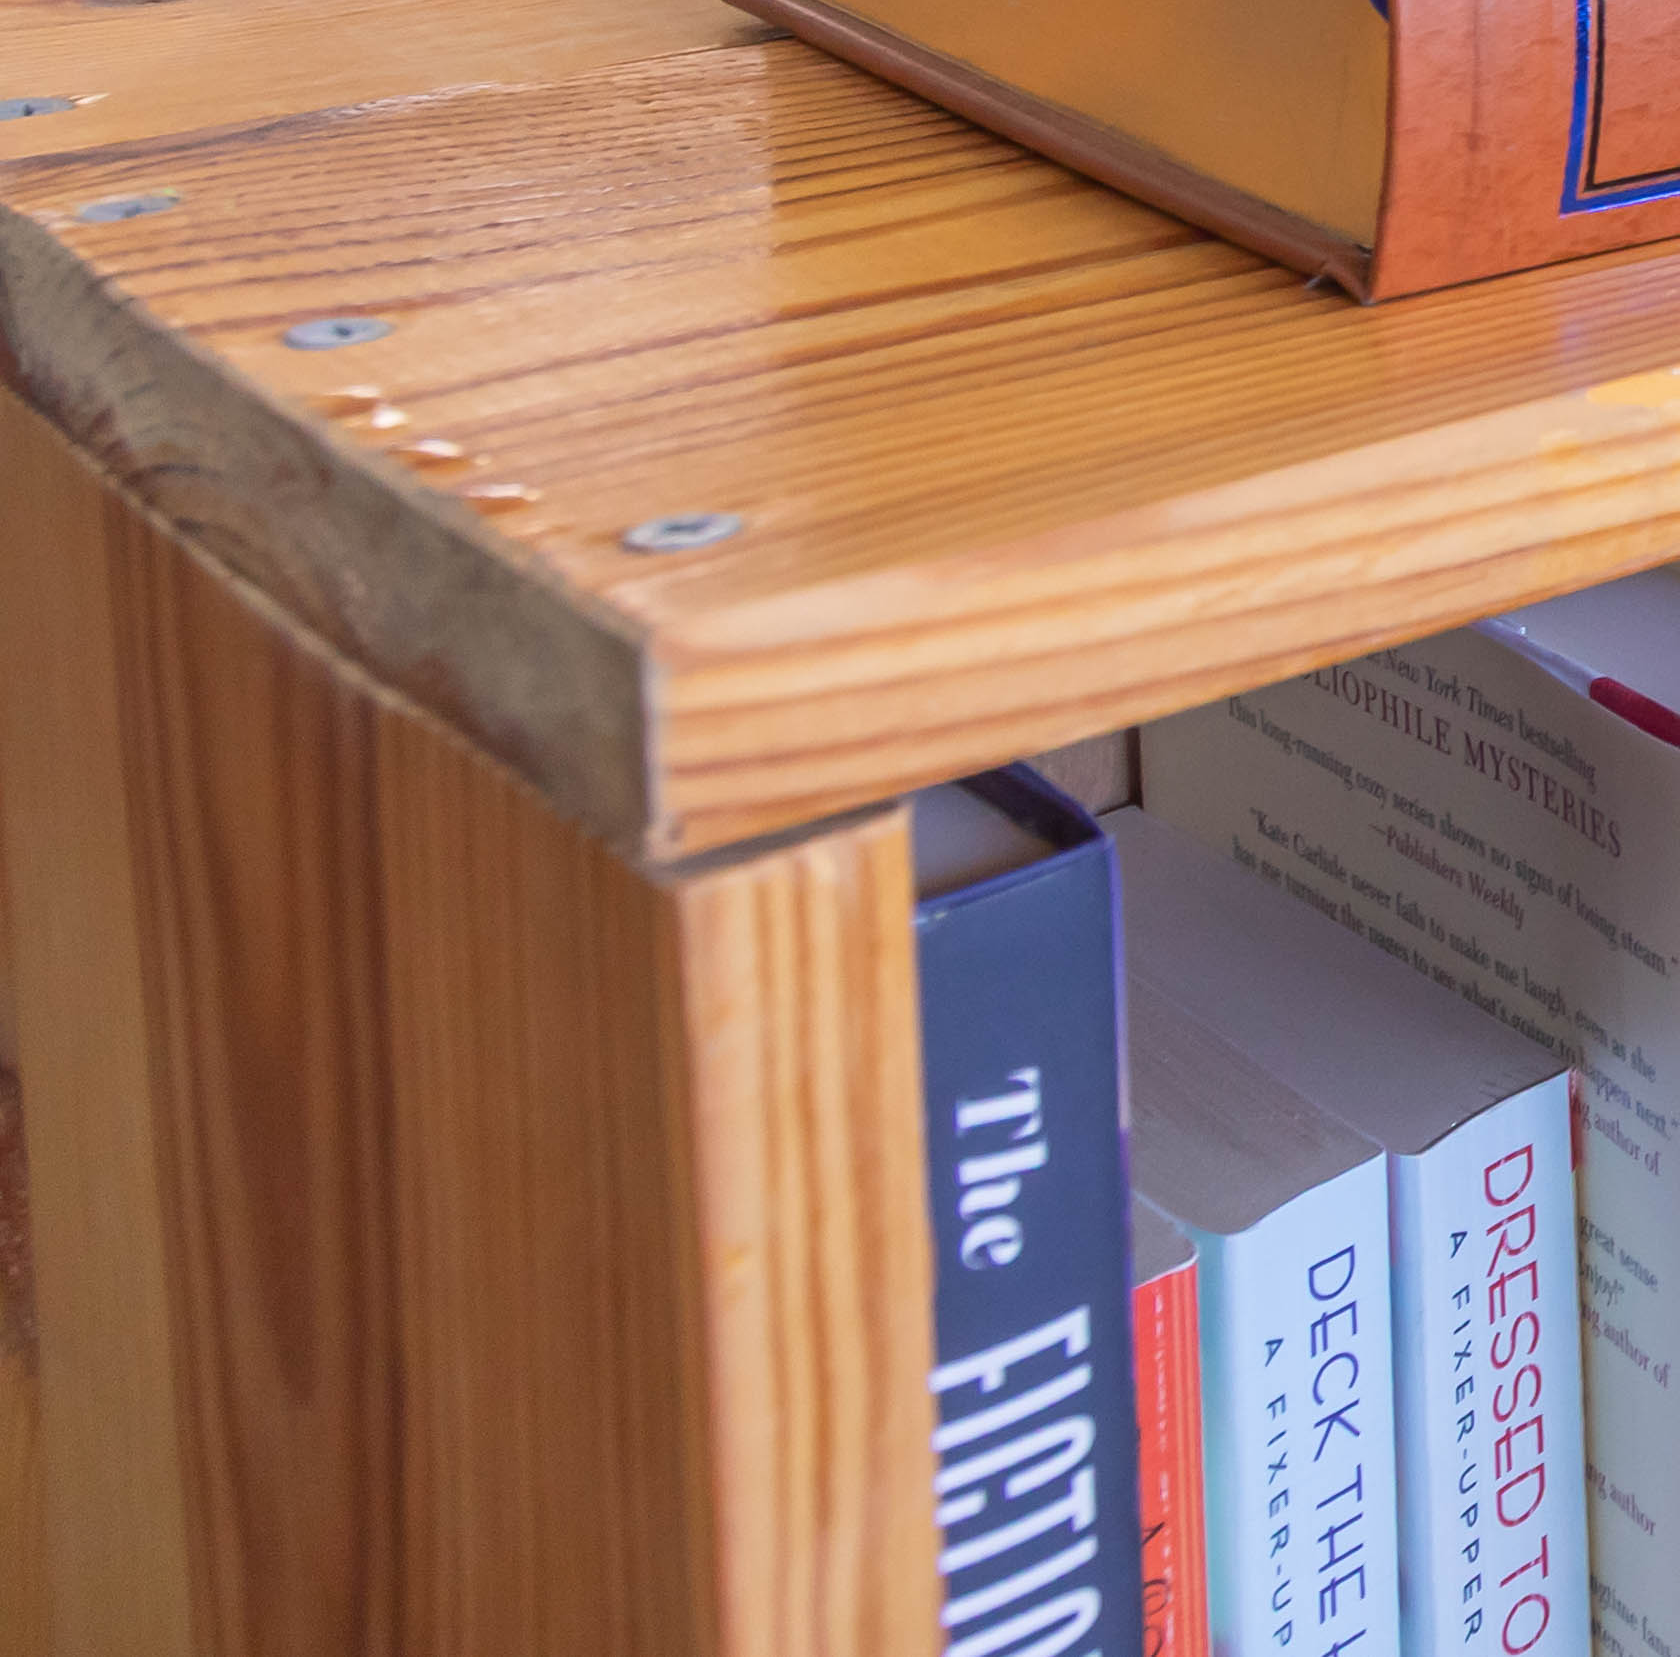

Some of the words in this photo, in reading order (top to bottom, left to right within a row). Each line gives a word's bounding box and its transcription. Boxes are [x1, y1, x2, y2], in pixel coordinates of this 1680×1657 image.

[1426, 665, 1461, 703] York
[1467, 685, 1514, 732] Times
[1517, 708, 1598, 795] bestselling
[1463, 731, 1621, 858] MYSTERIES
[1293, 833, 1347, 885] Carlisle
[1351, 874, 1392, 911] never
[1449, 925, 1491, 970] make
[1393, 790, 1435, 829] series
[1439, 811, 1496, 858] shows
[1514, 856, 1554, 898] signs
[1467, 870, 1525, 931] Weekly
[955, 1066, 1049, 1271] The
[1449, 1231, 1468, 1259] A
[1264, 1337, 1284, 1367] A
[1307, 1244, 1360, 1462] DECK
[1483, 1144, 1545, 1528] DRESSED
[1265, 1394, 1293, 1646] FIXER-UP
[1451, 1286, 1484, 1645] FIXER-UPPER
[1315, 1463, 1367, 1625] THE
[1499, 1535, 1551, 1657] TO
